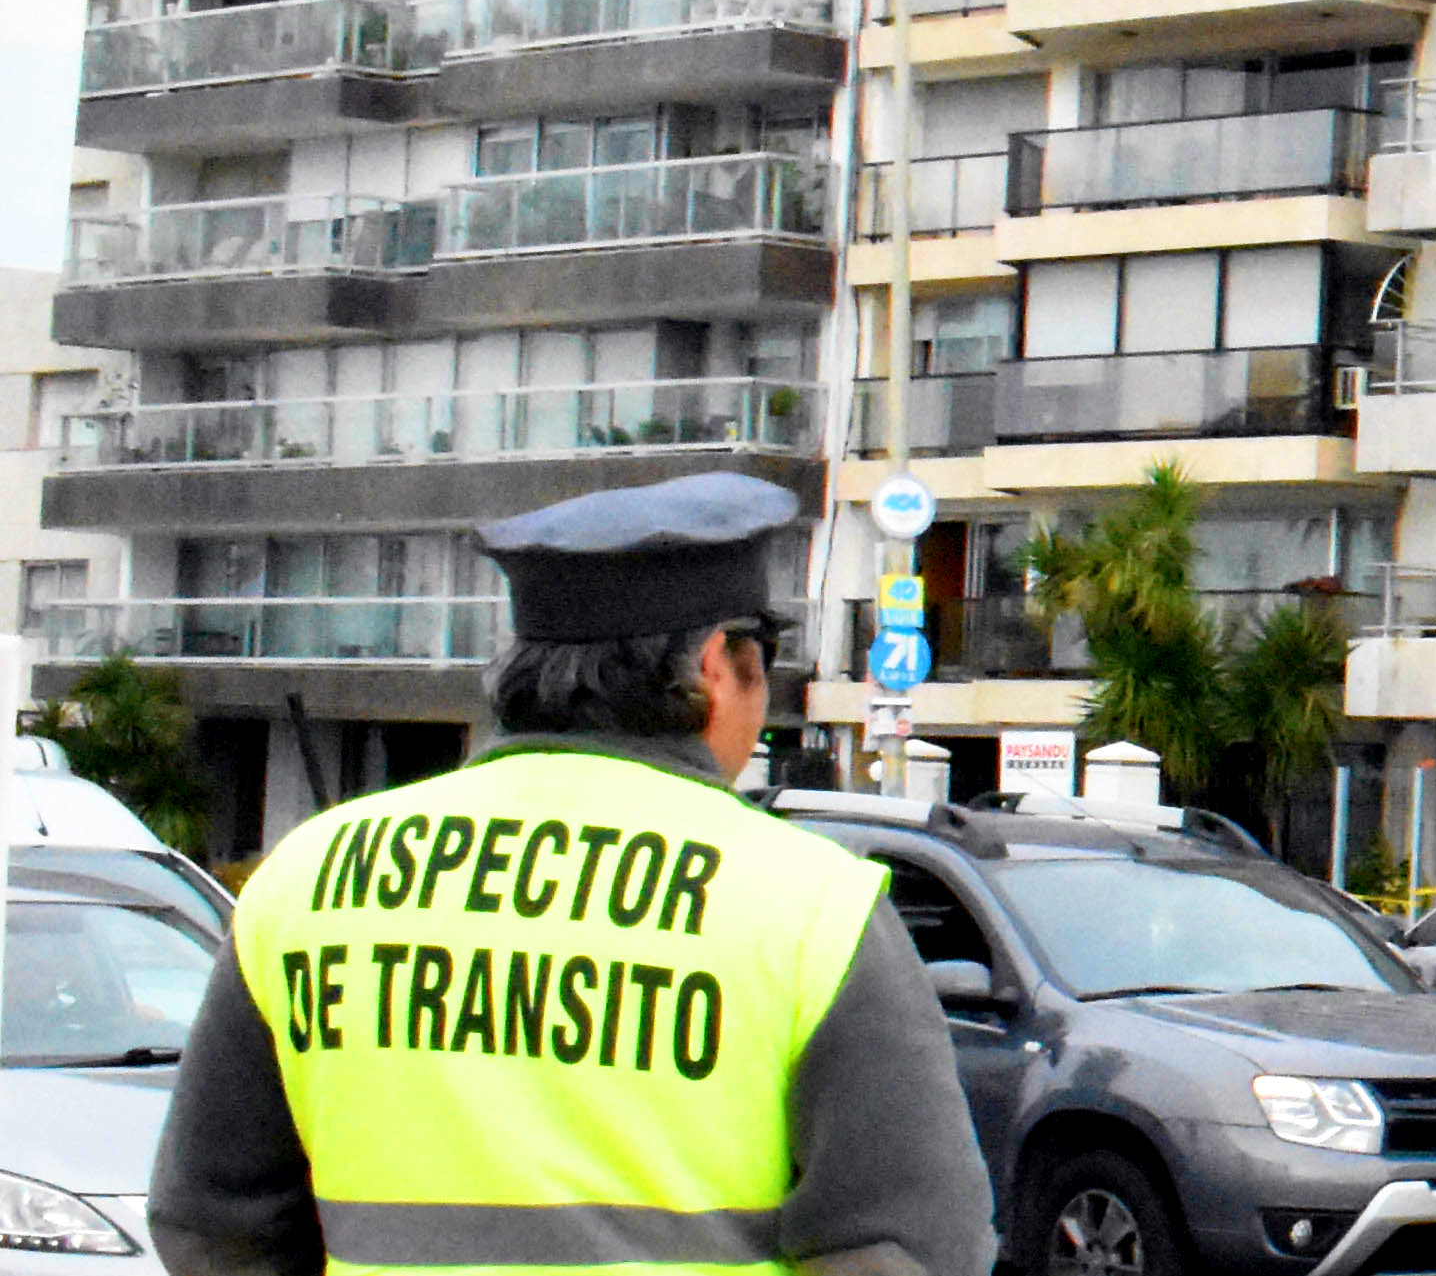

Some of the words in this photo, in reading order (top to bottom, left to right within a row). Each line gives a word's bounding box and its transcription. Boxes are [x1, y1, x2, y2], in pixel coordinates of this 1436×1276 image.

[311, 814, 722, 936] INSPECTOR
[282, 943, 349, 1054] DE
[371, 943, 724, 1082] TRANSITO
